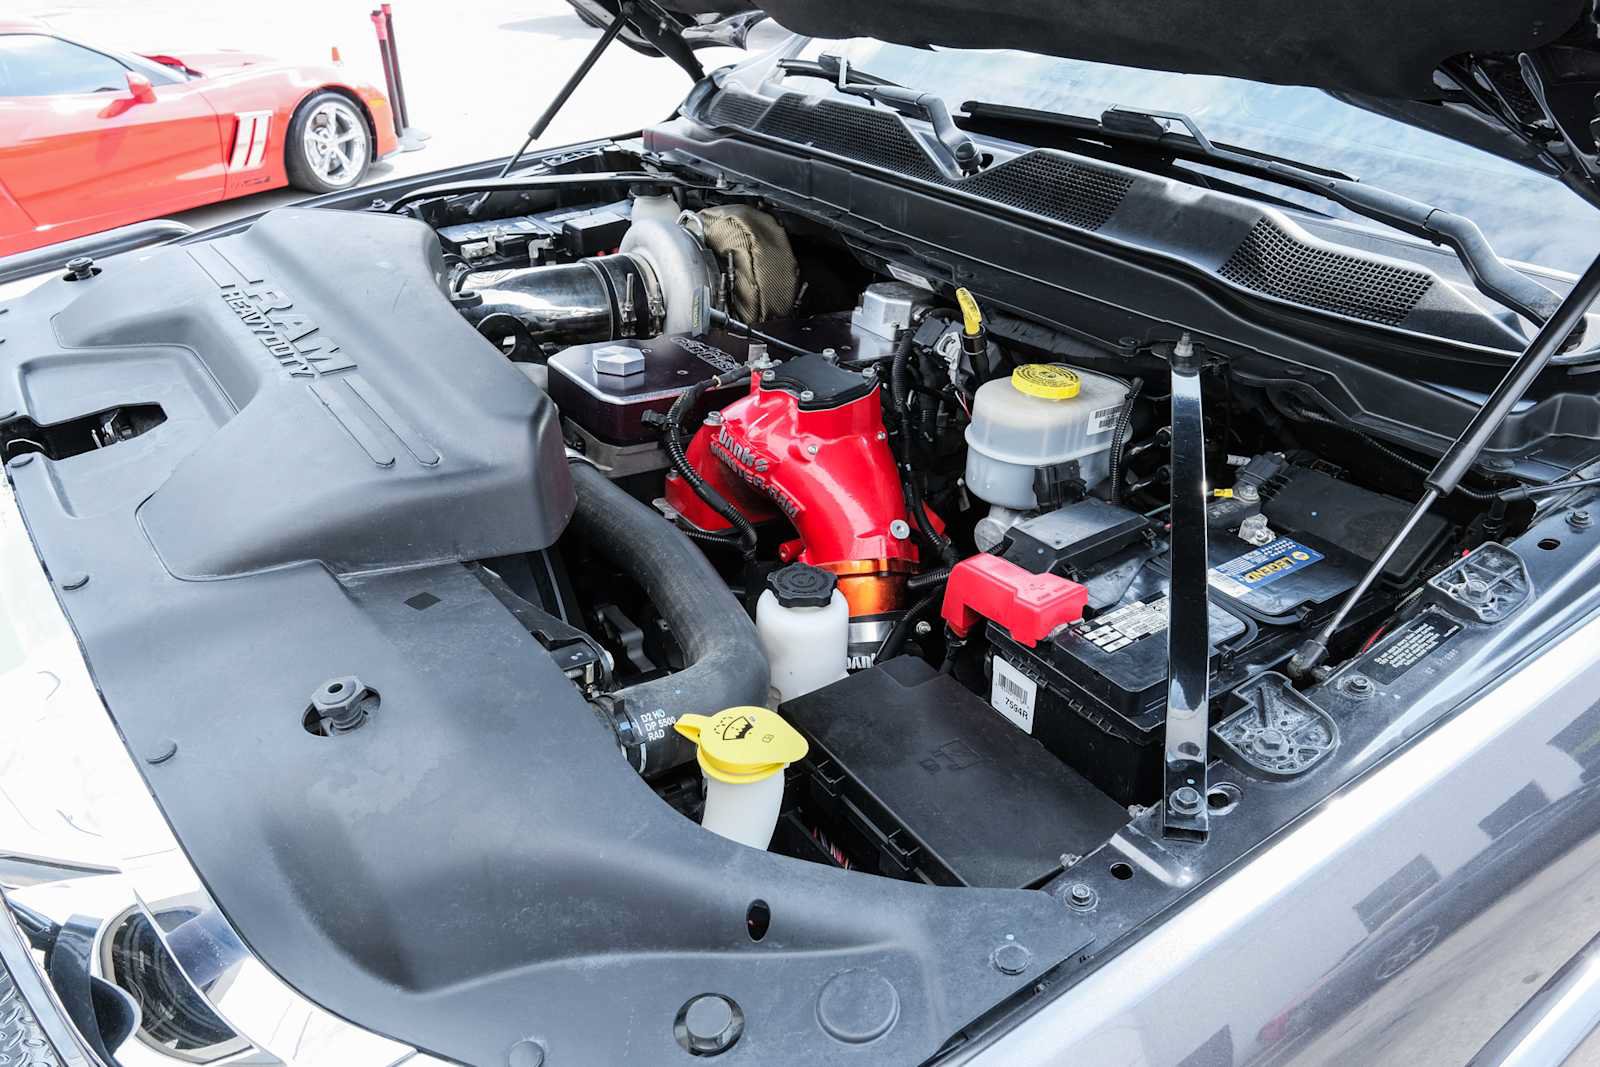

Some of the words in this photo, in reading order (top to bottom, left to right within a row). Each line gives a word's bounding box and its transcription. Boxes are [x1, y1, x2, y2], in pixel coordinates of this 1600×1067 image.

[221, 291, 275, 335] HEAVY
[260, 337, 317, 378] DUTY
[243, 288, 357, 376] RAM
[1244, 555, 1297, 584] LEGEND
[645, 721, 657, 732] DP
[657, 716, 676, 728] 5500
[648, 729, 665, 742] RAD
